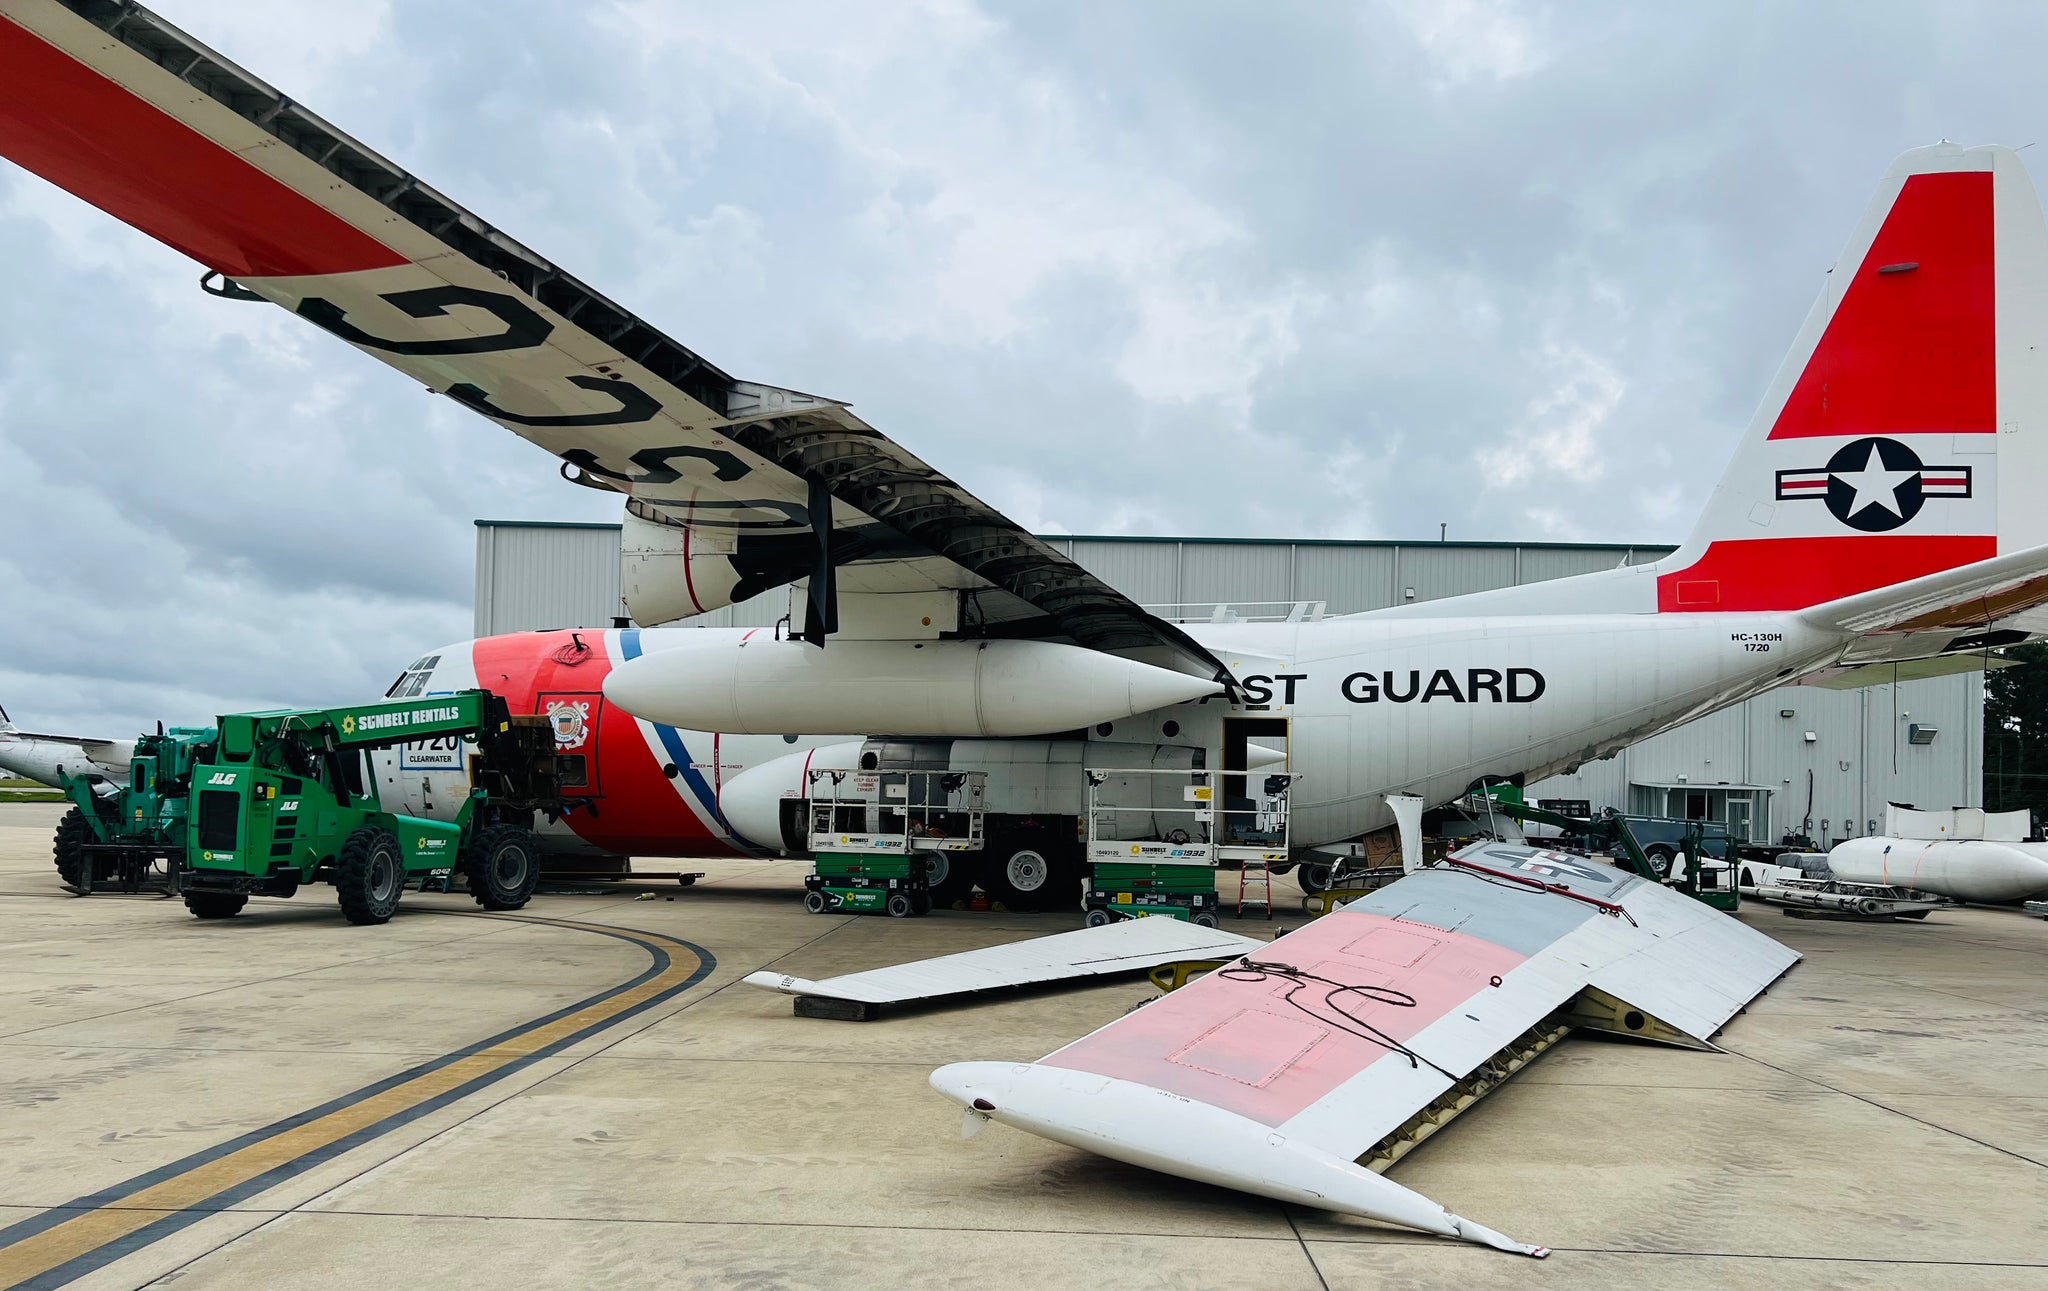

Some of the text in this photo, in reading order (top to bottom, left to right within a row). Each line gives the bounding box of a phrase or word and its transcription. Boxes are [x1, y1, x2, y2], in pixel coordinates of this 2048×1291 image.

[1731, 633, 1782, 641] HC-130H
[1744, 643, 1770, 652] 1720
[1177, 667, 1546, 705] AST GUARD
[358, 706, 459, 731] SUNBELT RENTALS
[409, 755, 452, 763] CLEARWATER
[207, 773, 237, 785] JLG
[280, 801, 299, 811] JLG
[1170, 849, 1206, 857] ES1932
